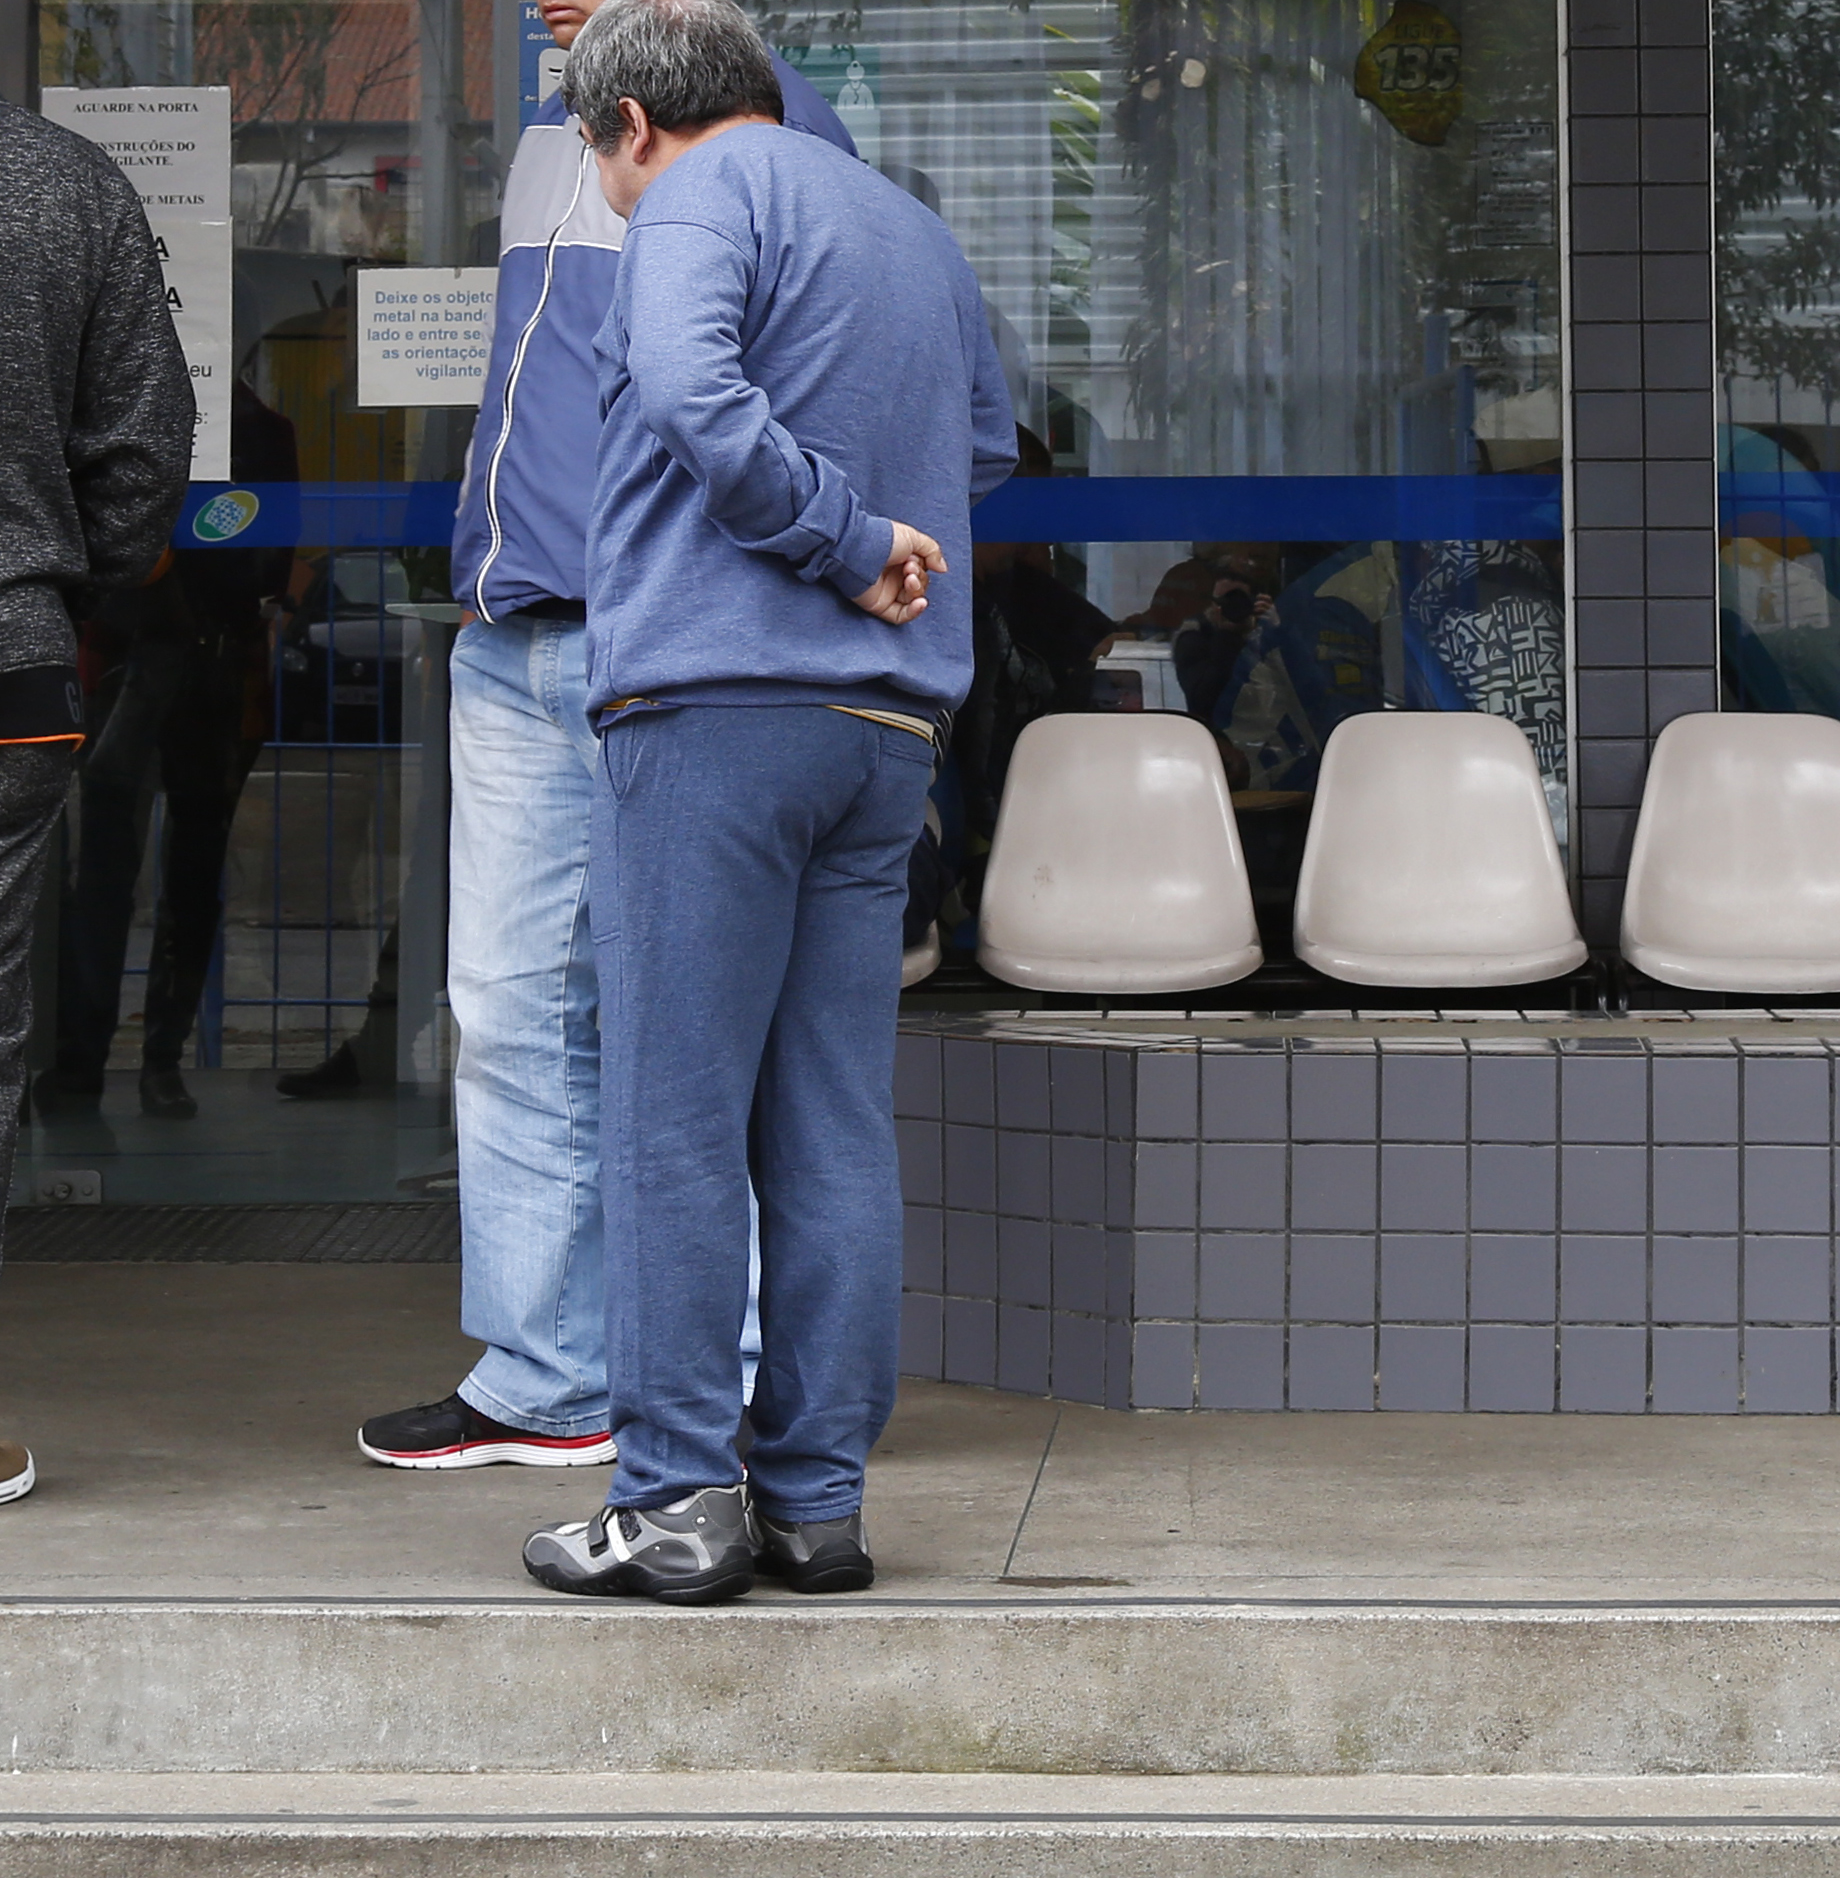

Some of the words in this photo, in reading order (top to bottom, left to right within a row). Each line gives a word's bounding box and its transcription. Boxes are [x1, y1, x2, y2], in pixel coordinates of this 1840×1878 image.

[1373, 43, 1462, 94] 135
[73, 102, 135, 113] AGUARDE
[138, 102, 156, 112] NA
[158, 102, 199, 113] PORTA
[176, 142, 196, 152] DO
[158, 194, 206, 205] METAIS
[374, 290, 418, 304] Deixe
[422, 293, 442, 304] os
[373, 309, 416, 323] metal
[420, 312, 439, 323] na
[367, 328, 400, 341] lado
[404, 330, 414, 341] e
[418, 329, 459, 341] entre
[381, 348, 400, 360] as
